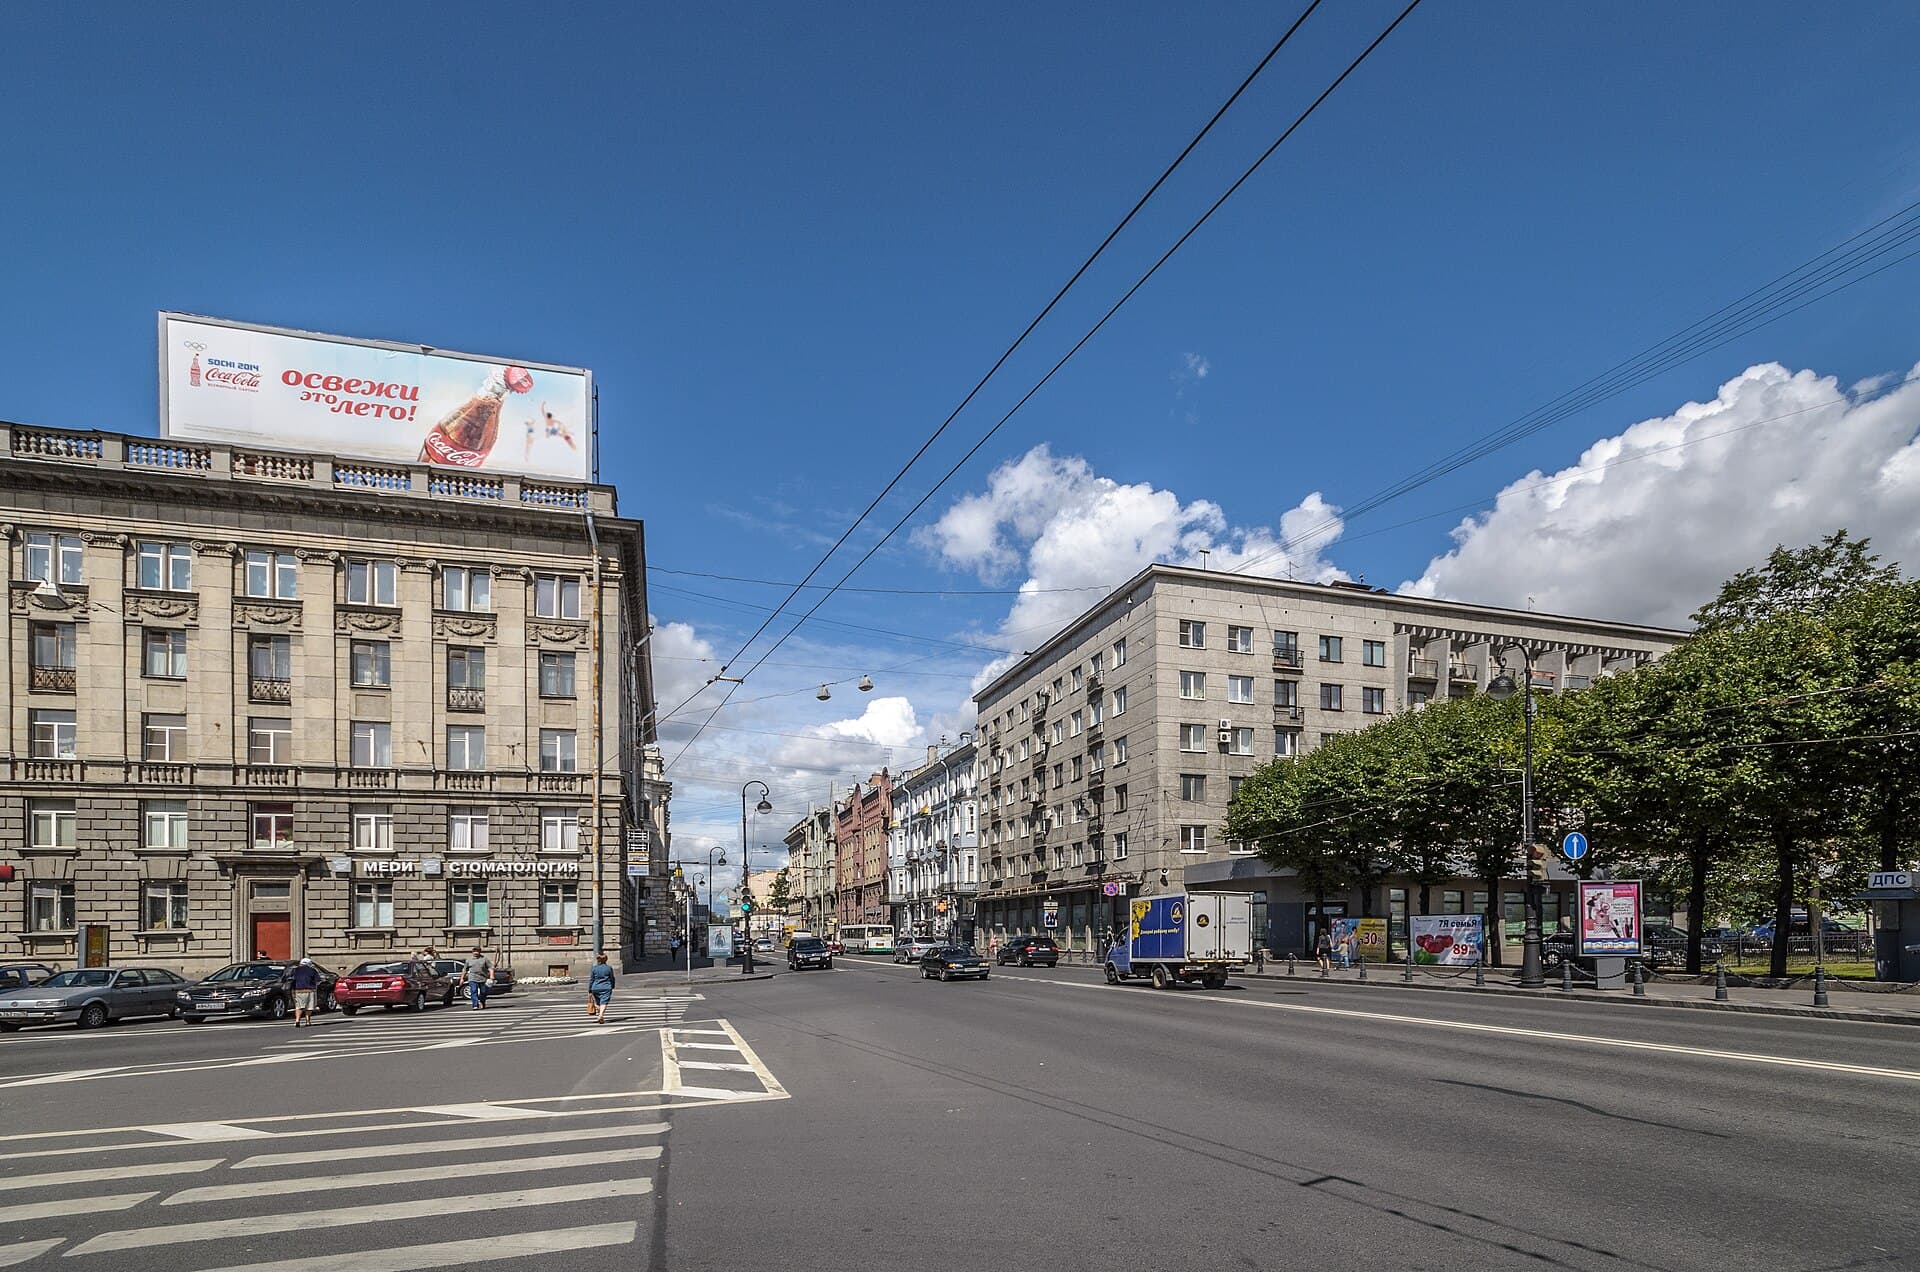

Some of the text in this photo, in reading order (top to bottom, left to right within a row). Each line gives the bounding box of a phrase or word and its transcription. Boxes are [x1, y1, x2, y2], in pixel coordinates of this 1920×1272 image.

[207, 358, 259, 372] SOCHI 2014
[205, 367, 263, 387] Coca-Cola
[449, 861, 579, 873] СТОМАТОЛОГИЯ
[1872, 874, 1907, 887] ДПС
[1438, 919, 1449, 928] 7Я
[1453, 944, 1468, 955] 89
